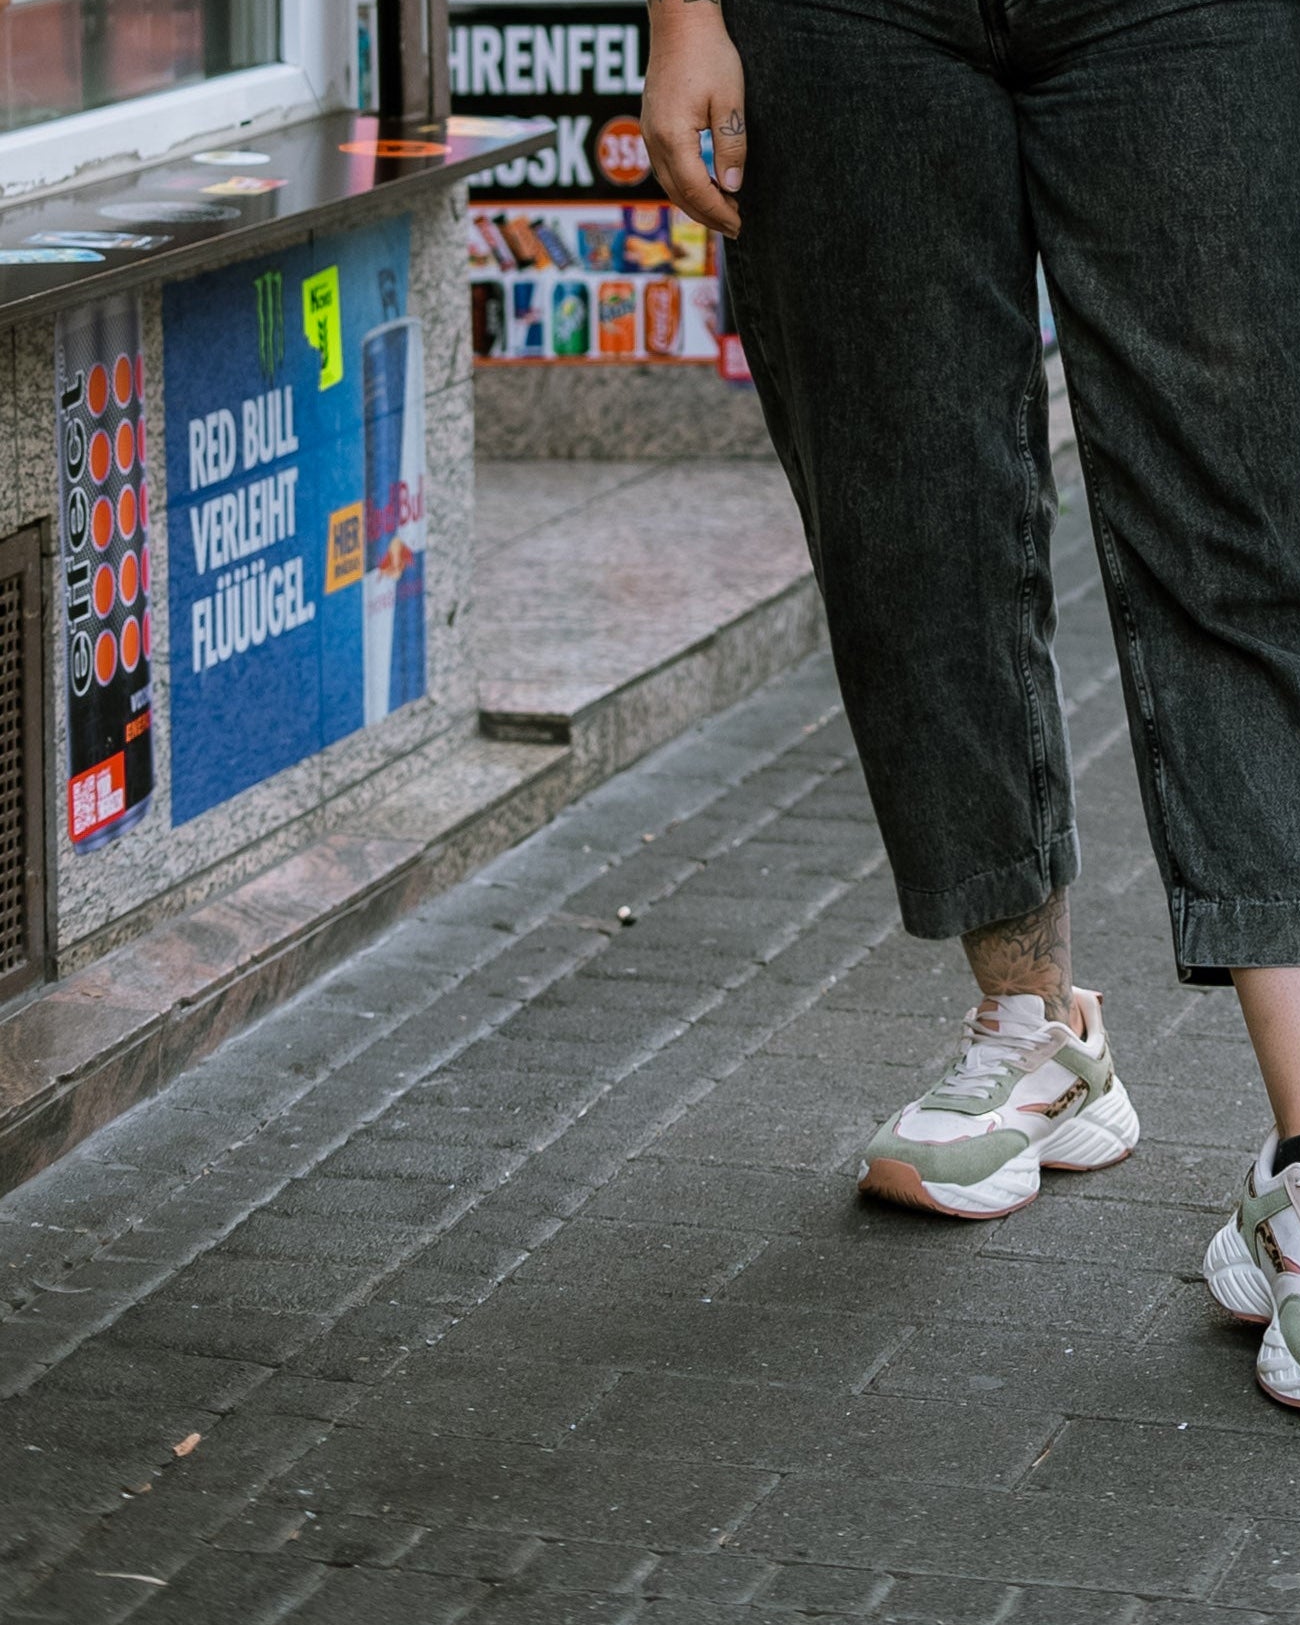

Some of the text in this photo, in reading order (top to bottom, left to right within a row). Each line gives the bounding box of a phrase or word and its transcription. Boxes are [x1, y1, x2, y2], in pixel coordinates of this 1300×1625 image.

[189, 385, 299, 491] RED BULL
[61, 369, 93, 697] effect
[189, 466, 299, 575] VERLEIHT
[192, 556, 316, 673] FLÜÜÜGEL.
